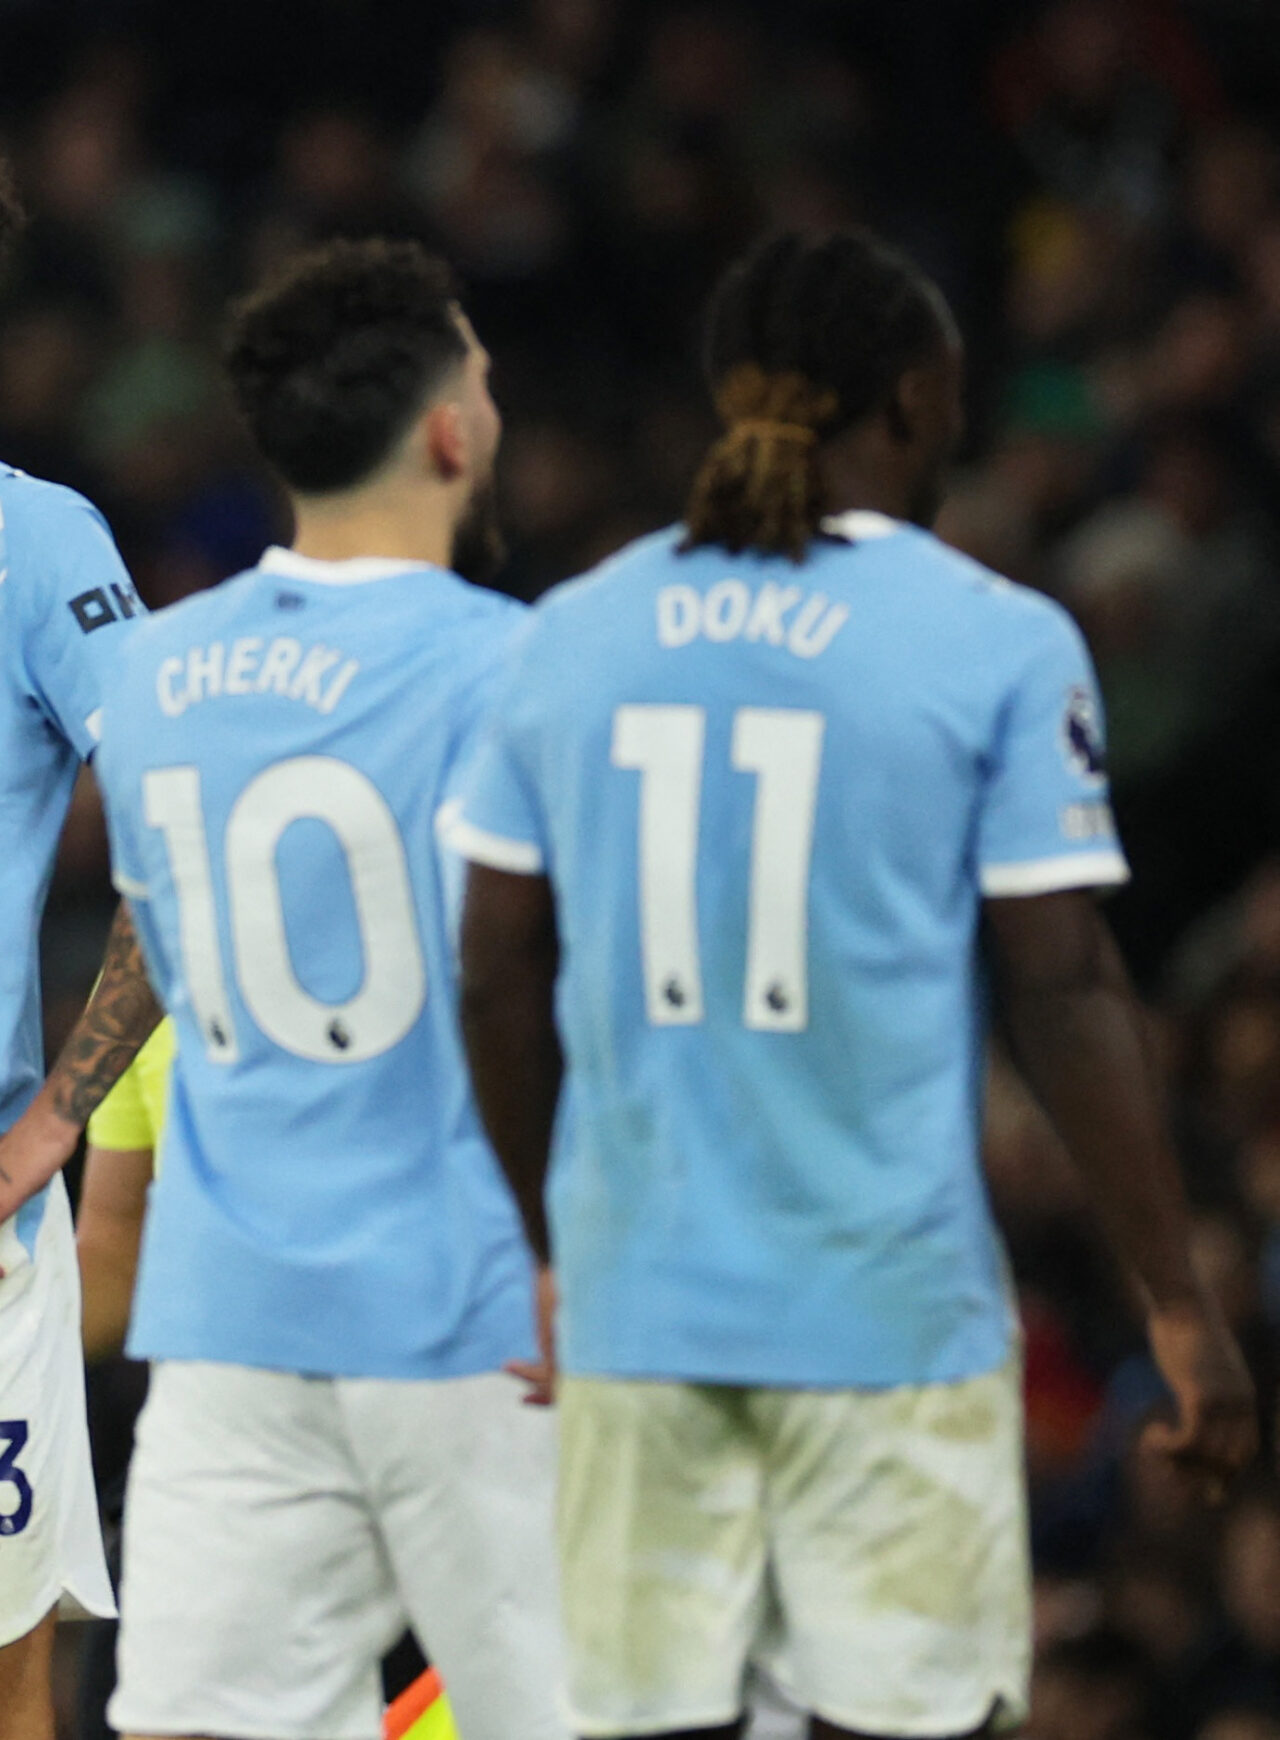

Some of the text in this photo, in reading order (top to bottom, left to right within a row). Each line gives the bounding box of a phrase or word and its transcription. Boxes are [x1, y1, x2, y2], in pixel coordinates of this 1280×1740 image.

[157, 636, 360, 717] CHERKI
[657, 578, 851, 659] DOKU
[142, 754, 426, 1064] 10
[611, 704, 825, 1034] 11
